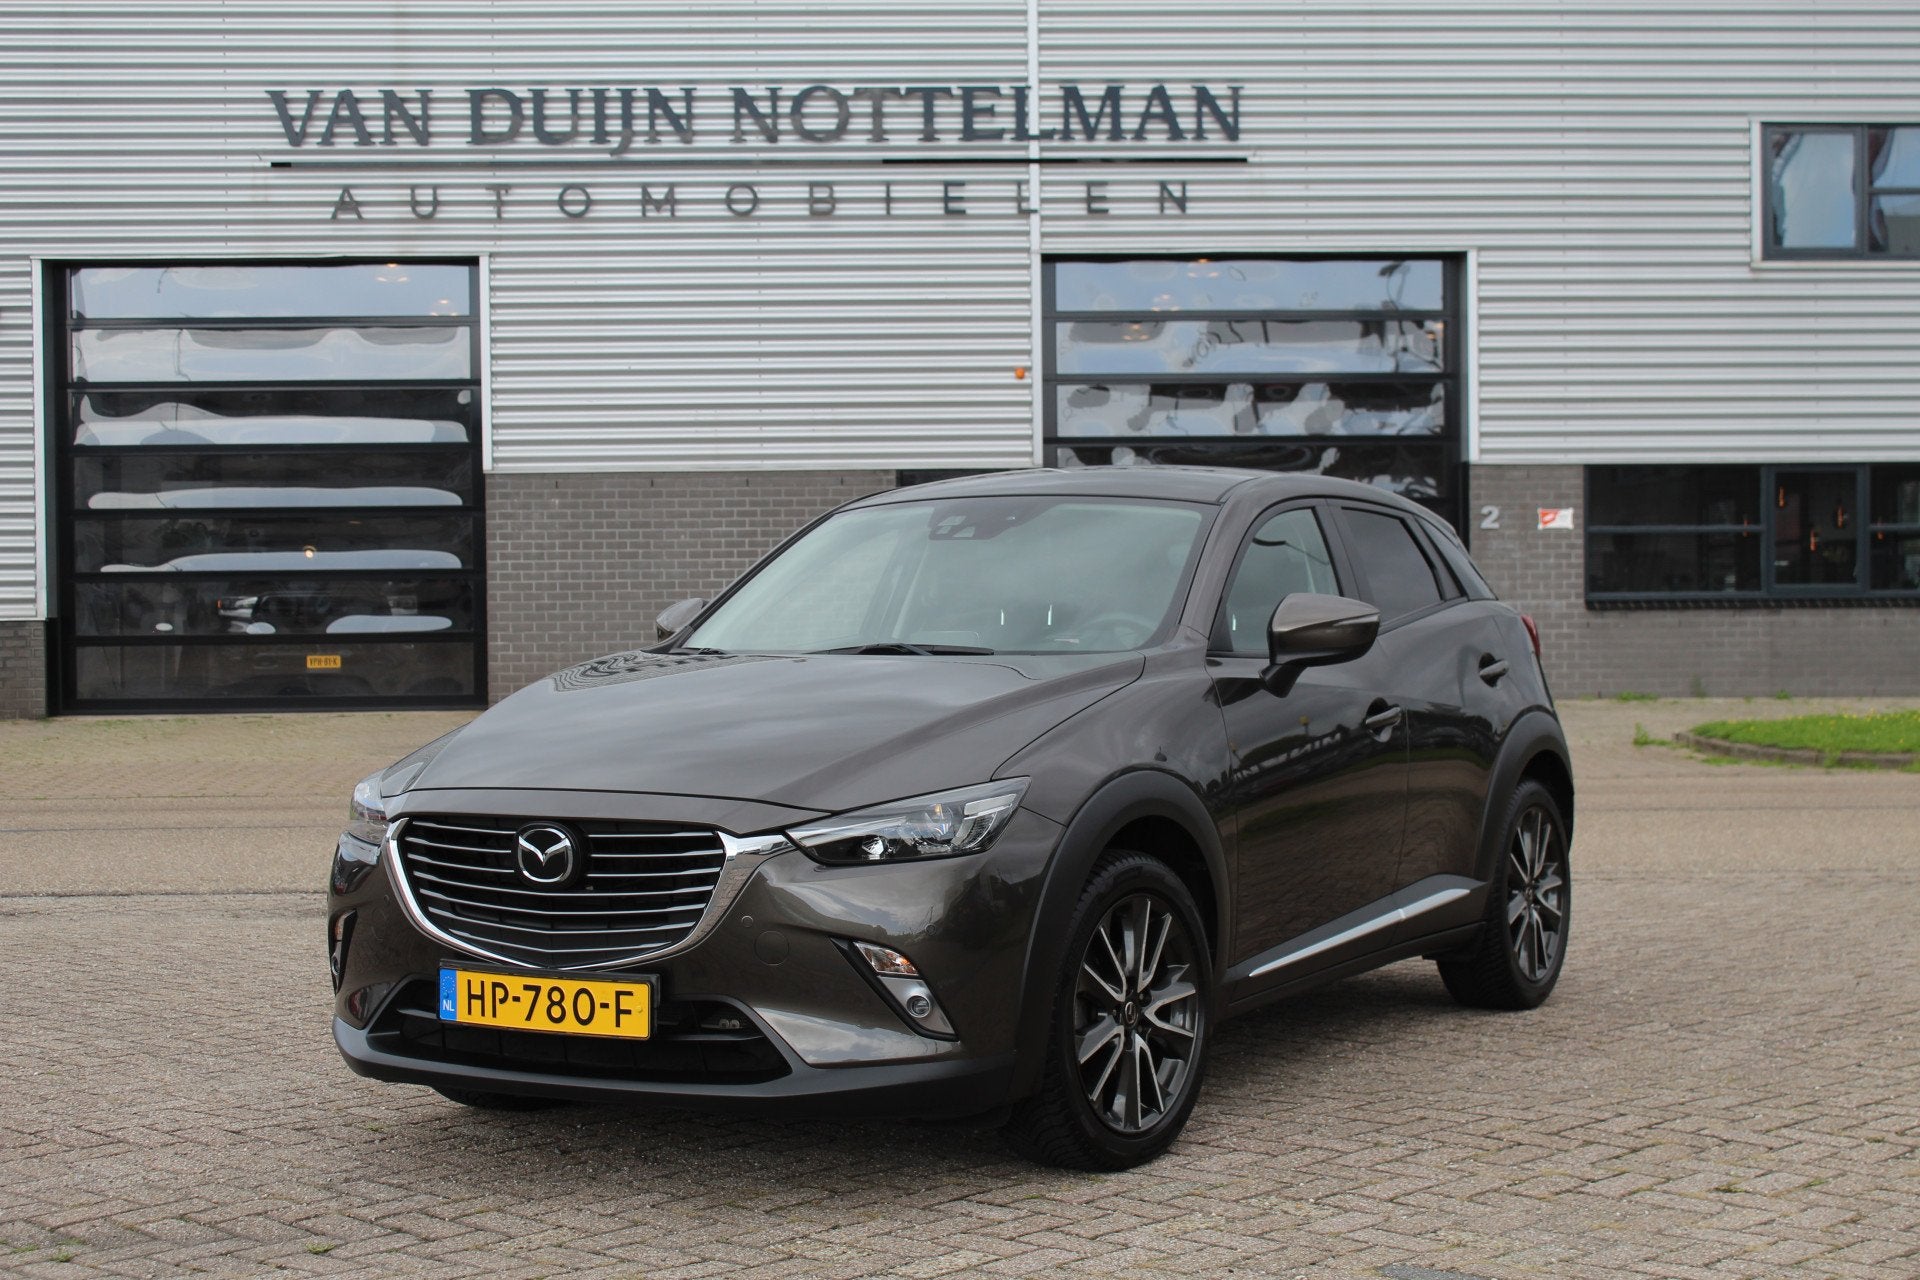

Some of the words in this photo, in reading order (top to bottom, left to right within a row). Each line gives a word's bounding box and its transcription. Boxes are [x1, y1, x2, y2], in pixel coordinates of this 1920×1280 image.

[265, 88, 434, 147] VAN
[465, 87, 698, 157] DUIJN
[728, 85, 1245, 144] NOTTELMAN
[330, 181, 1188, 220] AUTOMOBIELEN
[1480, 505, 1500, 529] 2
[442, 999, 455, 1012] NL
[466, 978, 634, 1028] HP-780-F
